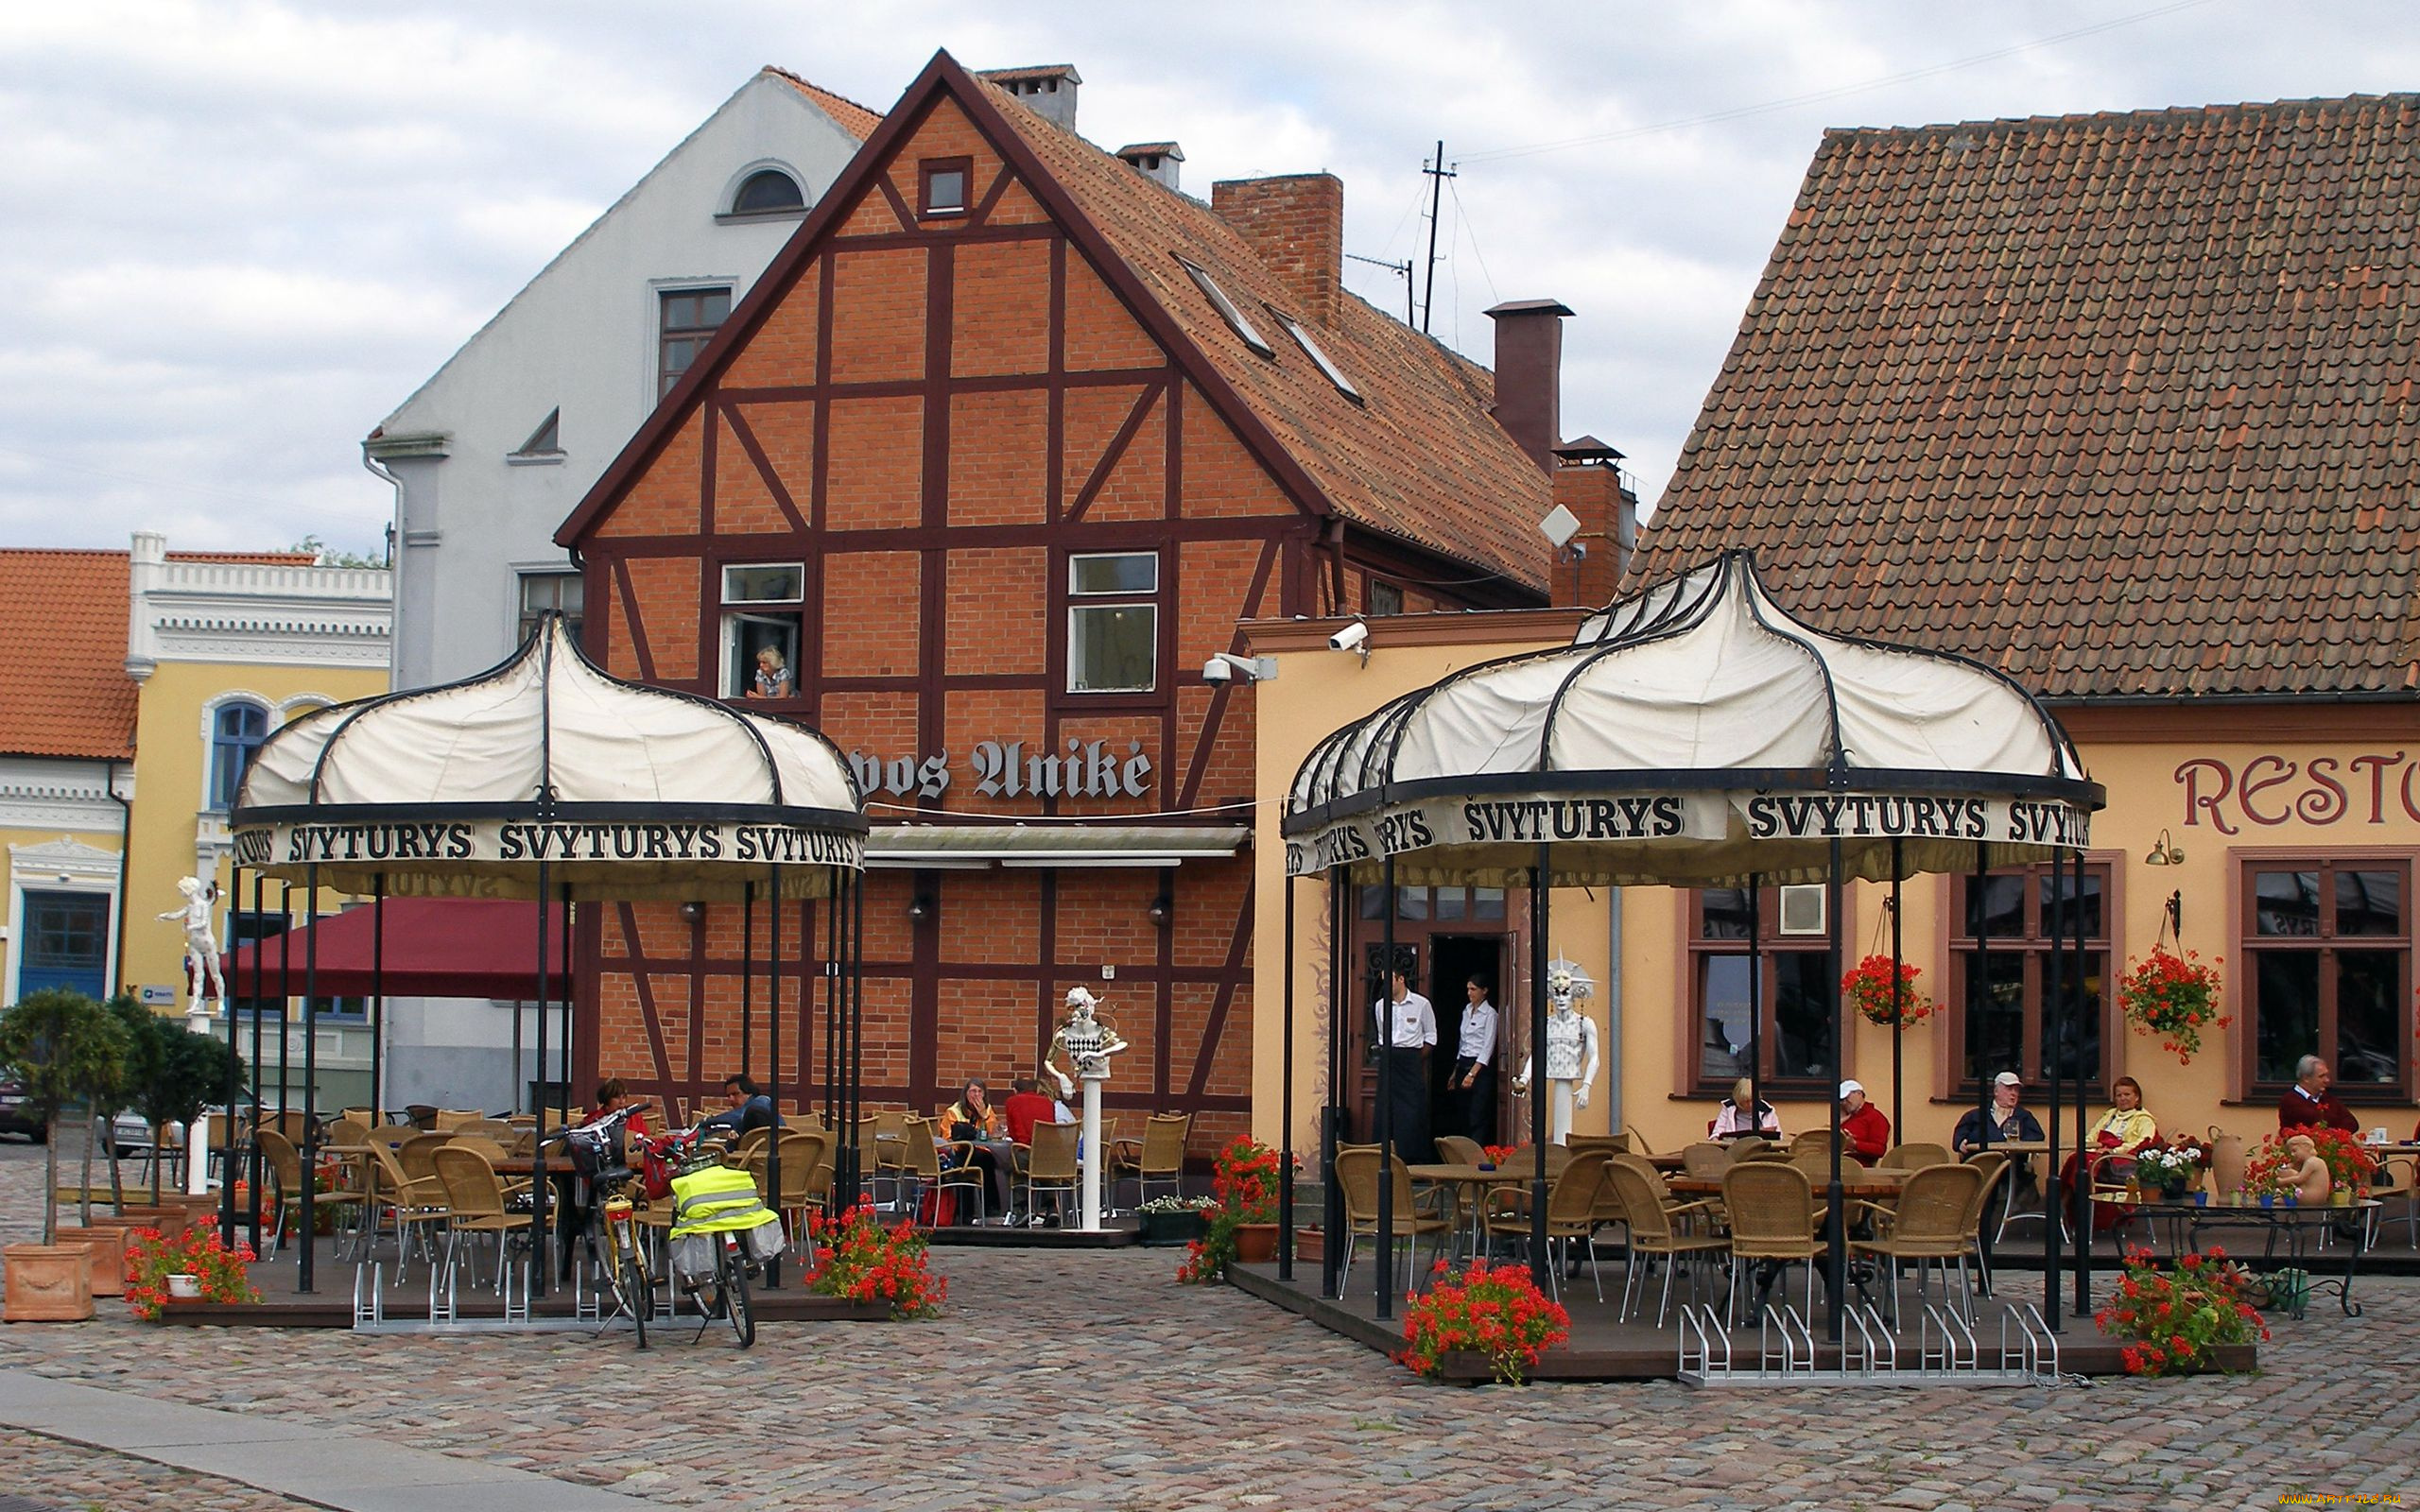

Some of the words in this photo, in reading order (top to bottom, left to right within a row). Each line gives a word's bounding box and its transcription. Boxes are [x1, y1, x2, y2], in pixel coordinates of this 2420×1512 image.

[1464, 796, 1685, 841] ŠVYTURYS
[1748, 788, 1989, 838] ŠVYTURYS
[500, 818, 725, 859] ŠVYTURYS
